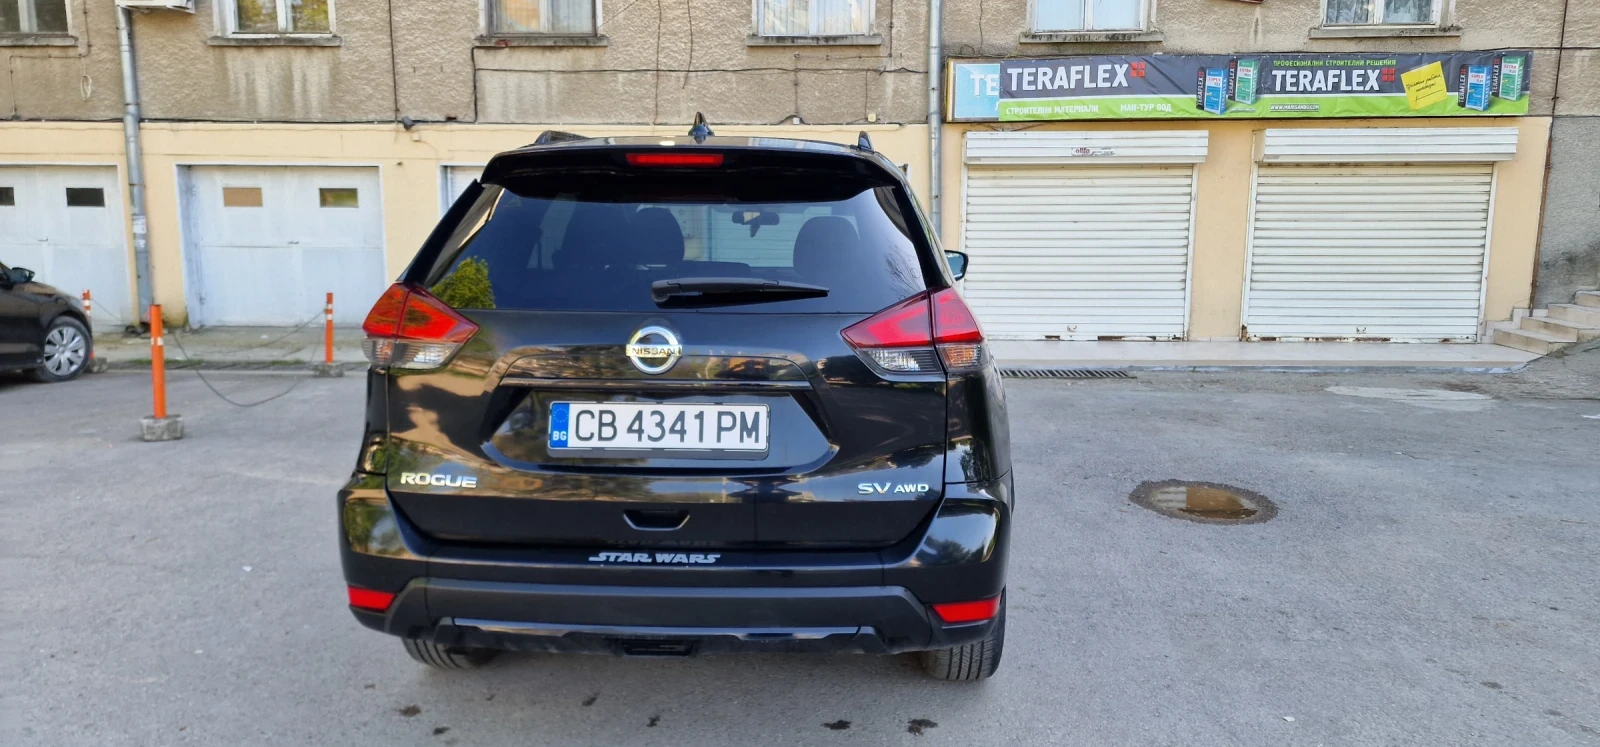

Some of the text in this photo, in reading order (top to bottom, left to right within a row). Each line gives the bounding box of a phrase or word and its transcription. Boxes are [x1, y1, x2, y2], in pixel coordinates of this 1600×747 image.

[1007, 63, 1129, 91] TERAFLEX
[1271, 69, 1380, 91] TERAFLEX
[1491, 64, 1501, 94] TERAFLEX
[1458, 74, 1467, 103] TERAFLEX
[1006, 106, 1052, 115] СТРОИТЕЛНИ
[1054, 104, 1099, 114] МАТЕРИАЛИ
[1156, 103, 1172, 113] ООД
[631, 347, 676, 356] NISSAN
[575, 409, 760, 444] CB 4341 PM
[552, 430, 567, 442] BG
[400, 472, 478, 489] ROGUE
[857, 482, 929, 495] SV AWD
[588, 552, 720, 564] STAR WARS
